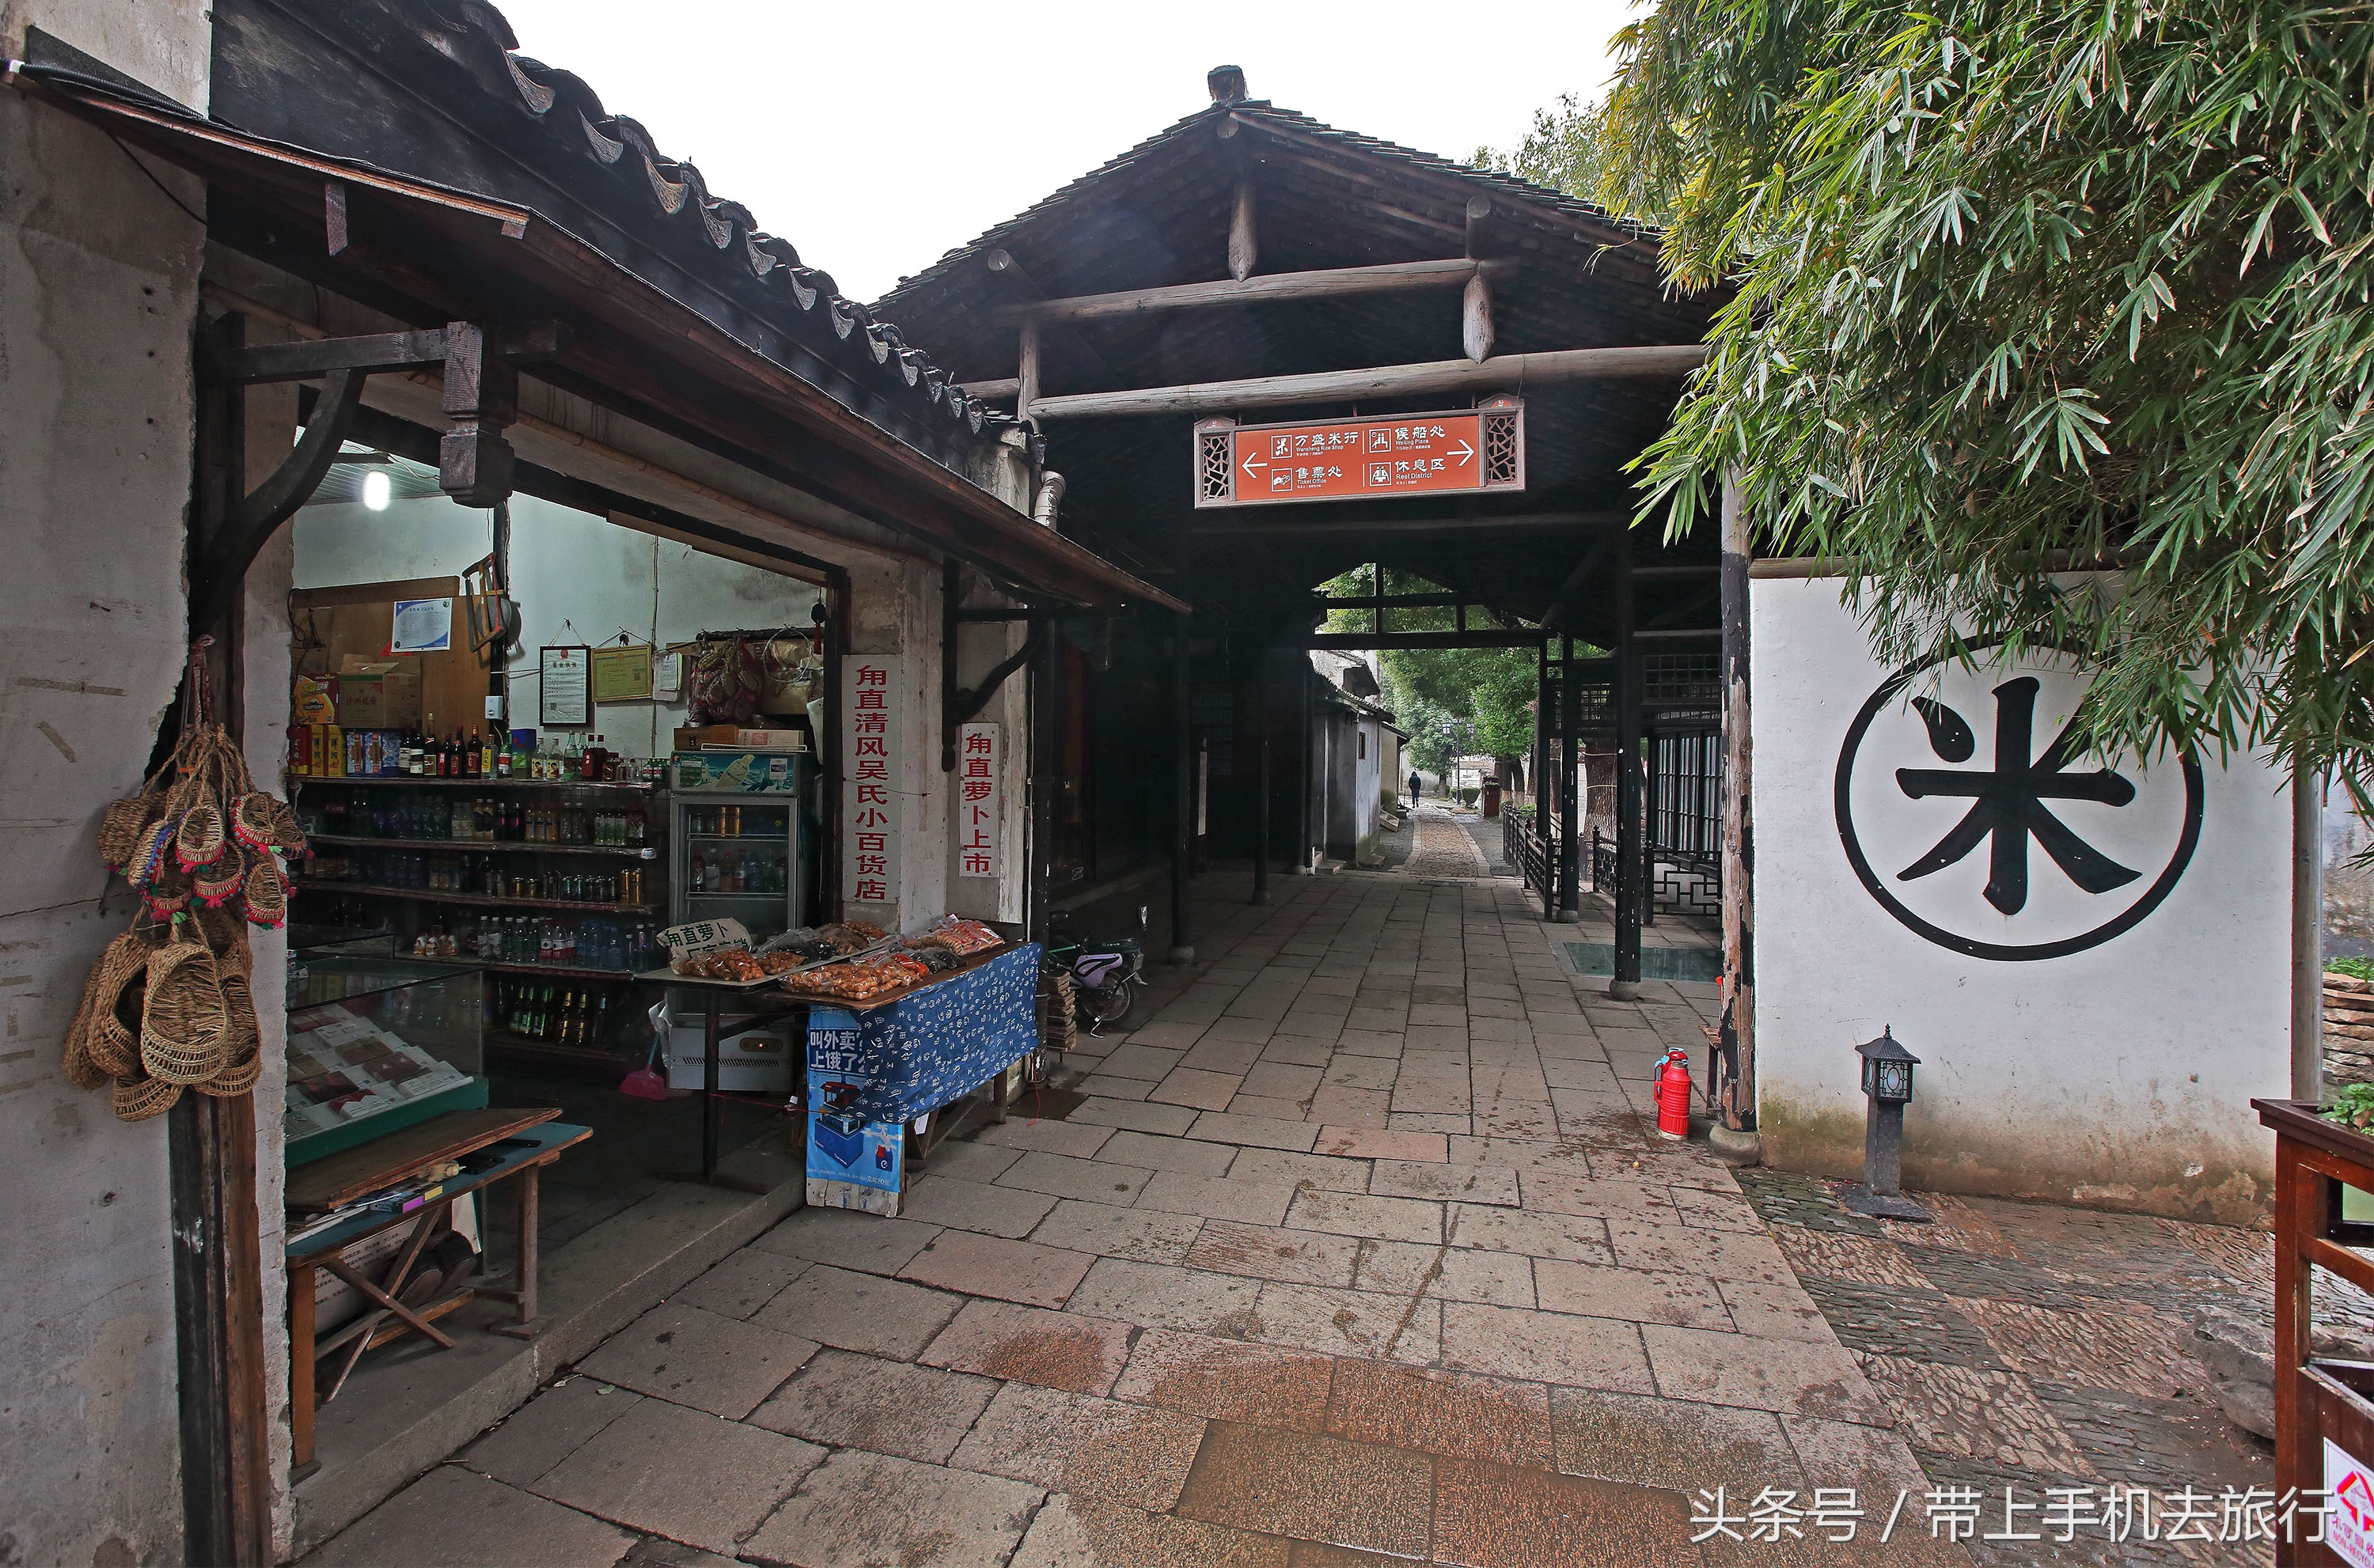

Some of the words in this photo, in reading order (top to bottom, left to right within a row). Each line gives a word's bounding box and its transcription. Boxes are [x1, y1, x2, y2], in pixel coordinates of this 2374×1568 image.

[1295, 431, 1359, 447] 万盛米行
[1295, 465, 1343, 479] 售票处
[1394, 458, 1447, 473] 休息区
[1895, 676, 2144, 916] 米
